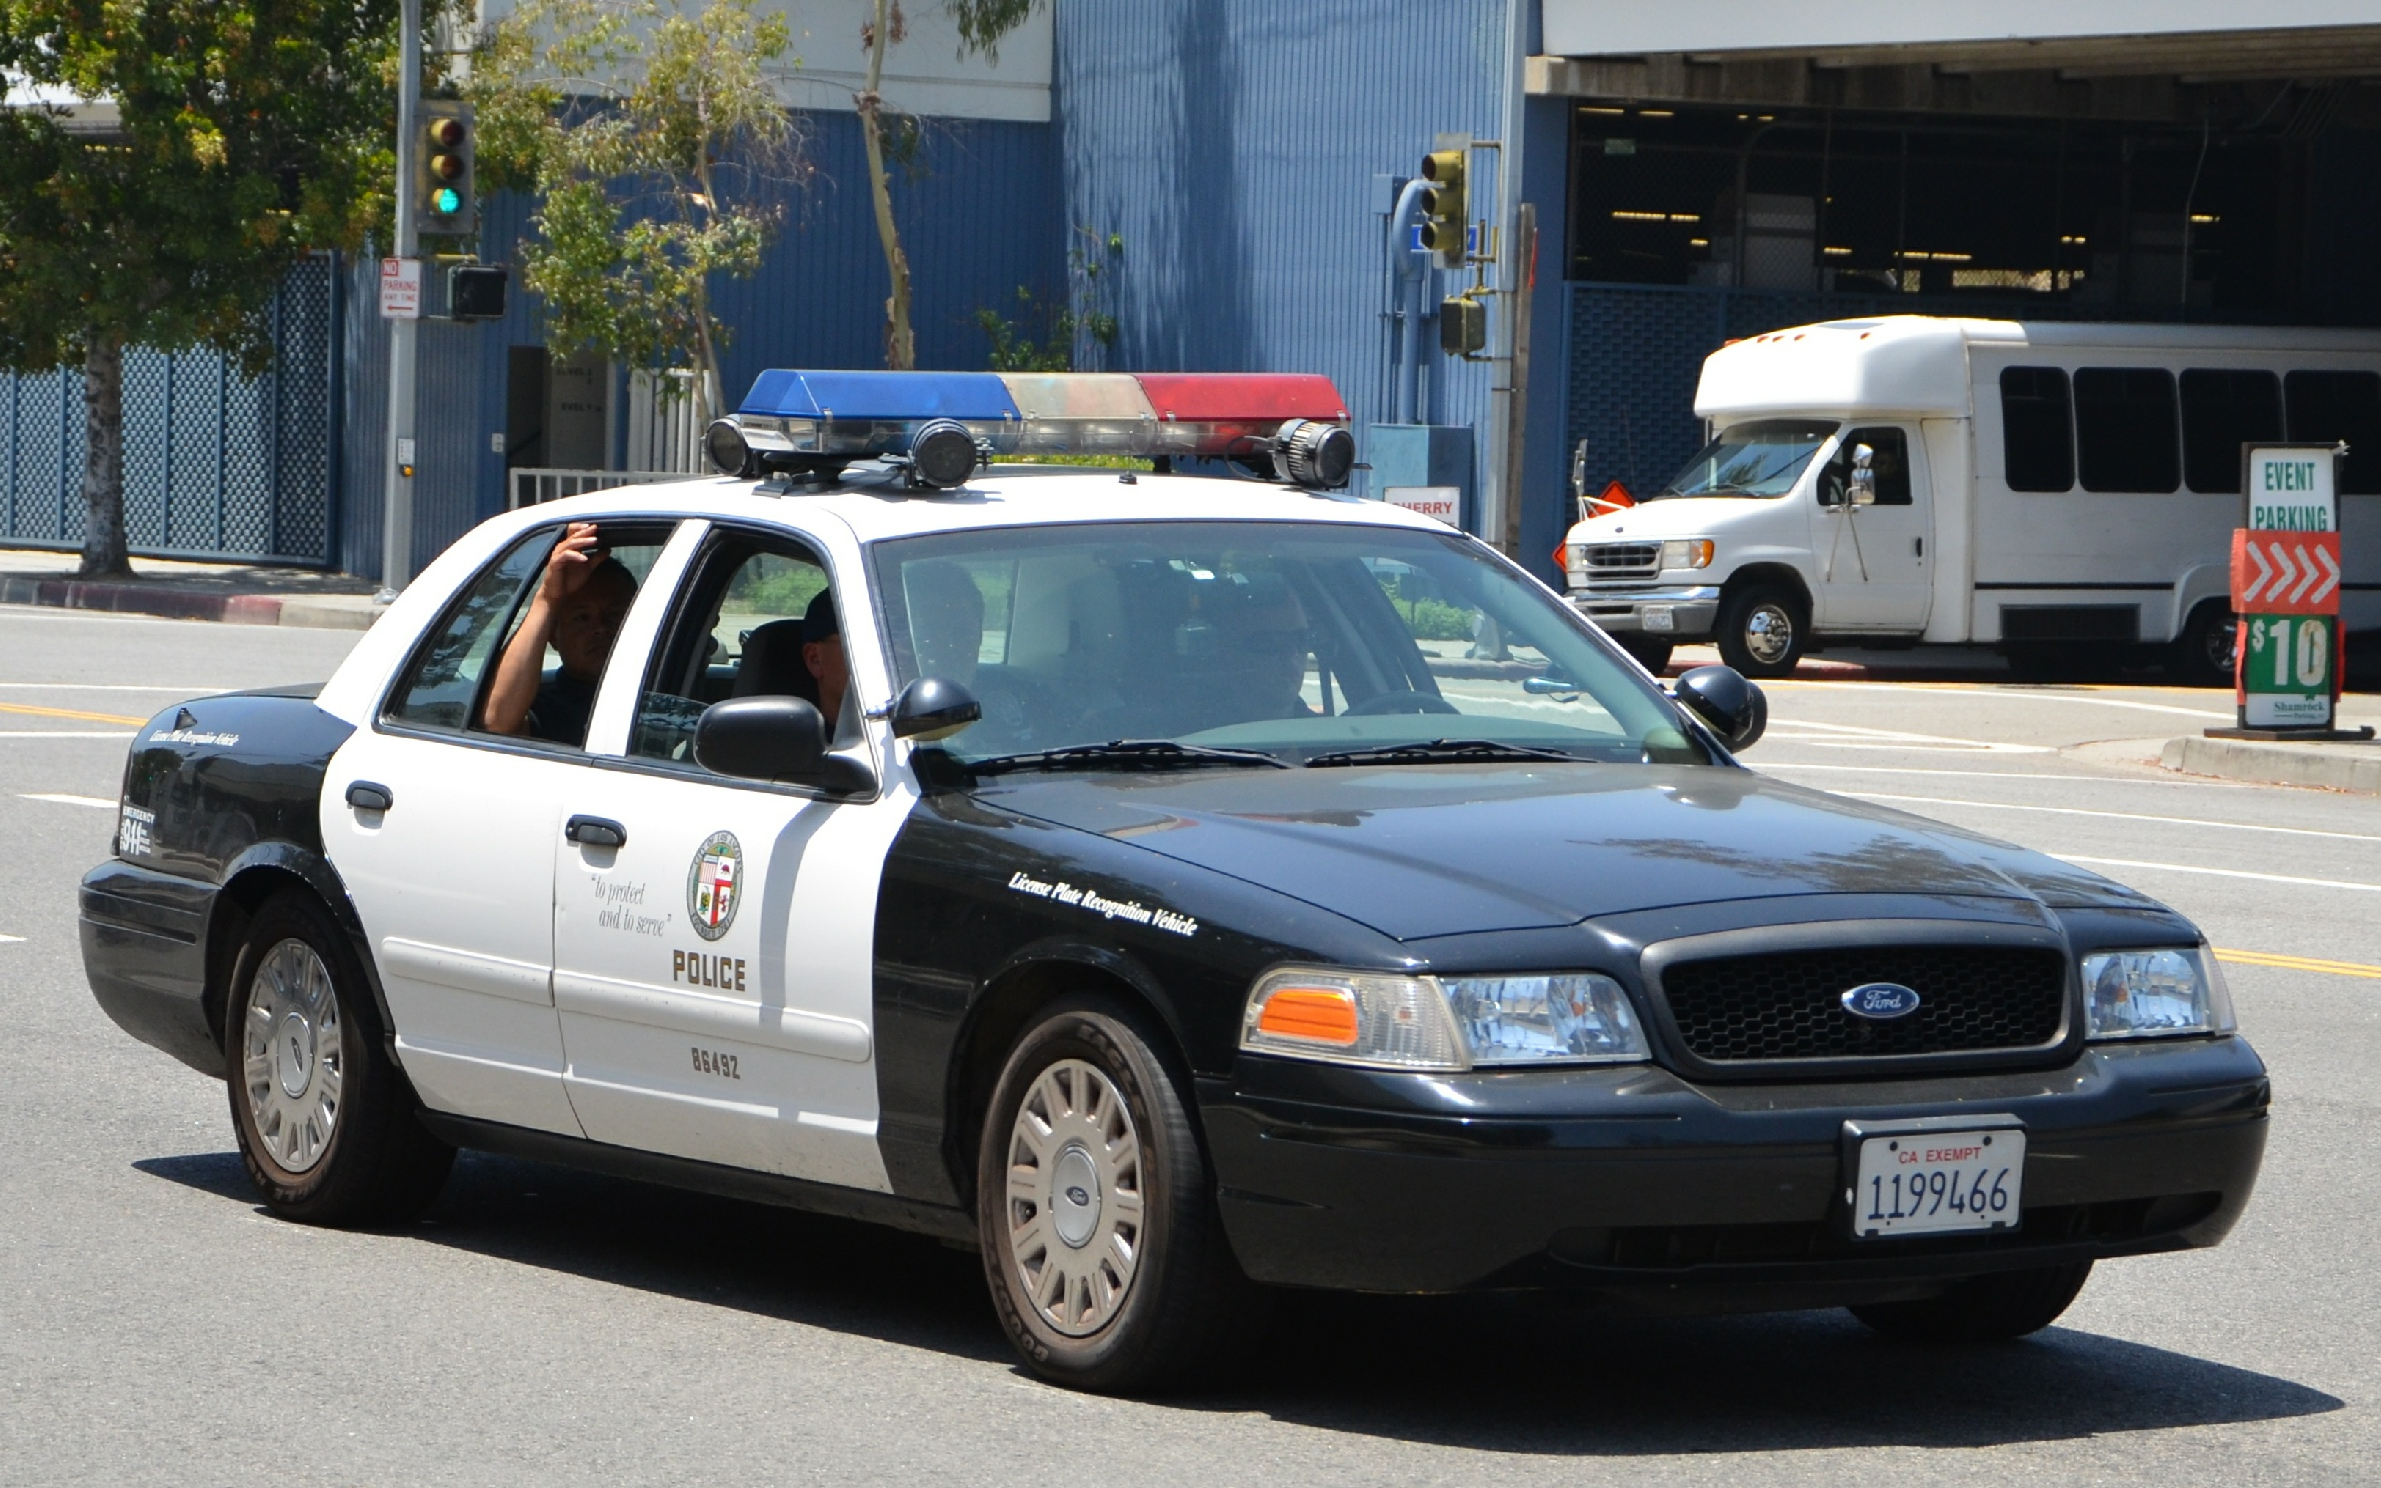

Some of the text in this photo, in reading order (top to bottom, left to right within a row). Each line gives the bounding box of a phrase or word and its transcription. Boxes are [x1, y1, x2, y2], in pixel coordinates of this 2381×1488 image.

[384, 261, 397, 275] NO
[383, 279, 417, 292] PARKING
[2264, 461, 2316, 492] EVENT
[2255, 505, 2328, 531] PARKING
[2252, 618, 2328, 688] $10
[2274, 701, 2325, 712] Shamrock
[123, 818, 142, 856] 911
[608, 880, 646, 905] protect
[1008, 871, 1199, 937] License Plate Recognition Vehicle
[598, 905, 621, 930] and
[623, 909, 636, 931] to
[673, 949, 746, 992] POLICE
[691, 1047, 741, 1080] 86492
[1898, 1146, 1982, 1164] CA EXEMPT
[1868, 1168, 2009, 1221] 1199466
